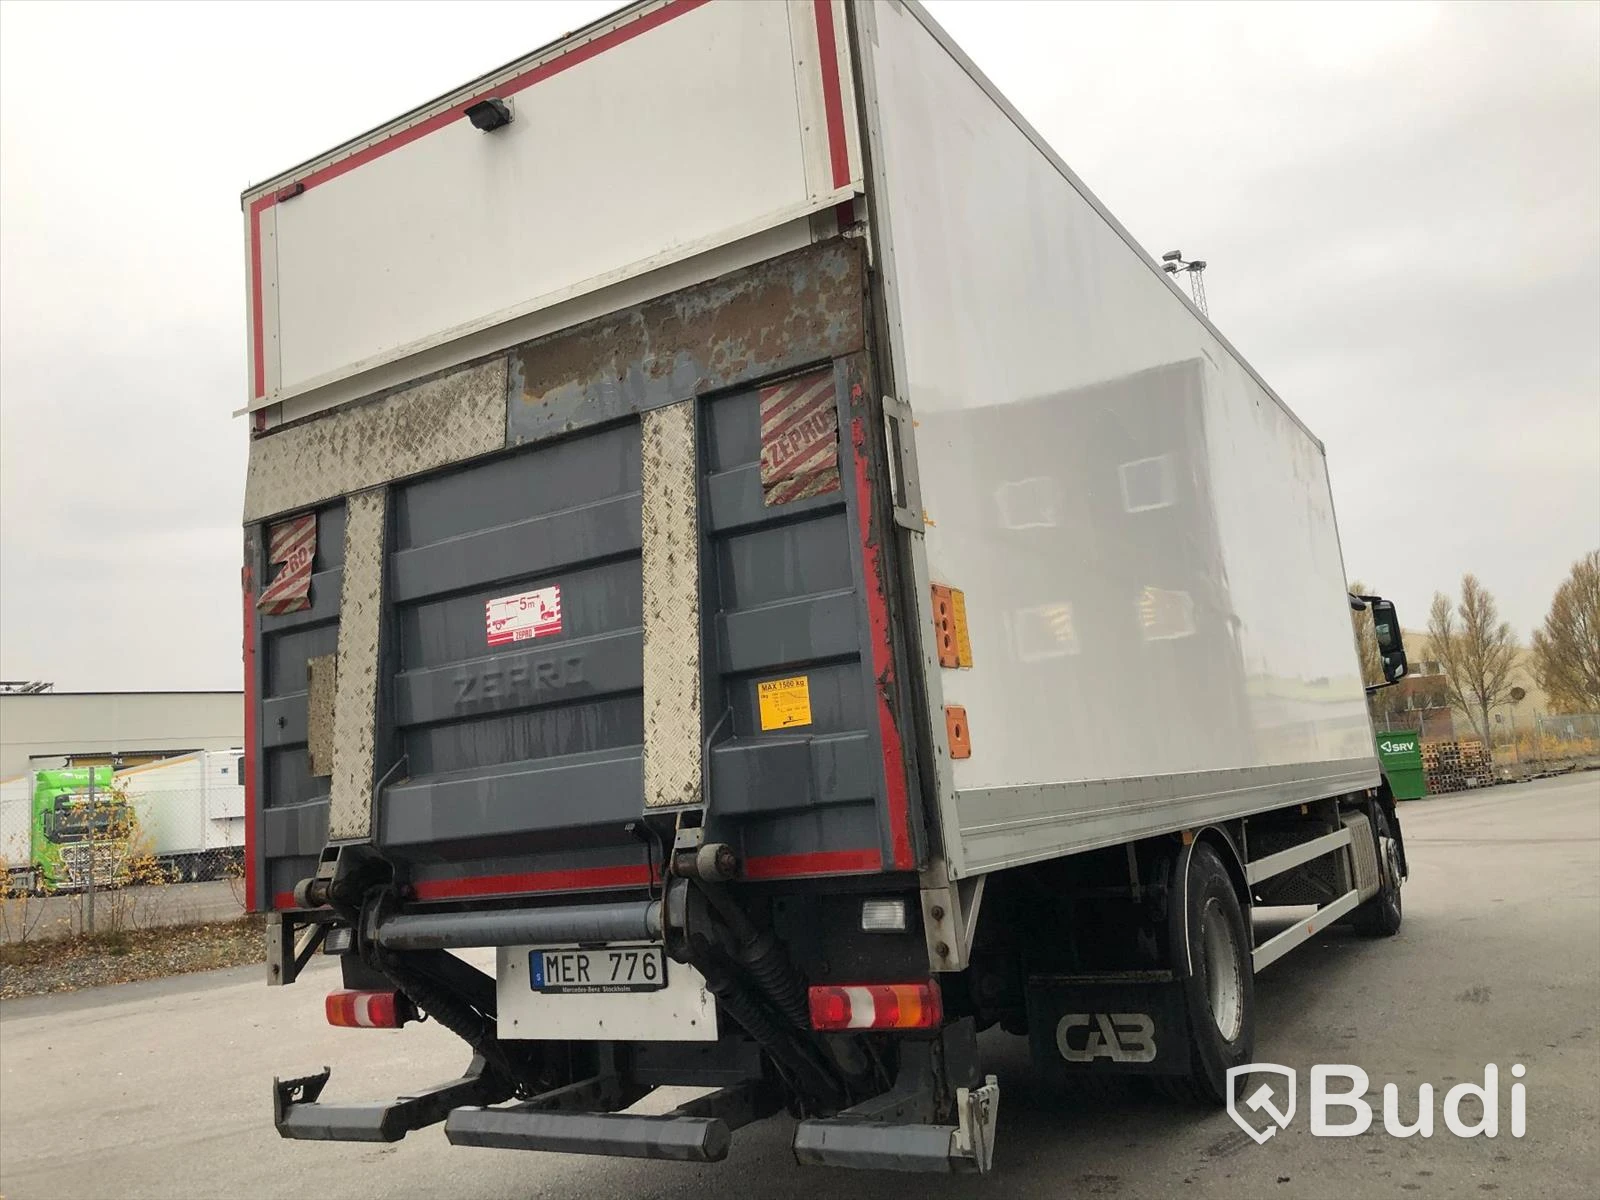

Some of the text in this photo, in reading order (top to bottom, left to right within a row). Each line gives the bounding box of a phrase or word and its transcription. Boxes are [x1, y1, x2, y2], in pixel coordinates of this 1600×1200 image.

[766, 408, 831, 469] ZEPRO
[519, 597, 535, 610] 5 m
[515, 629, 532, 640] ZEPRO
[761, 680, 805, 691] MAX 1500 kg
[1391, 742, 1414, 752] SRV
[546, 952, 656, 983] MER 776
[602, 984, 631, 993] Stockholm
[1056, 1013, 1157, 1063] CAB
